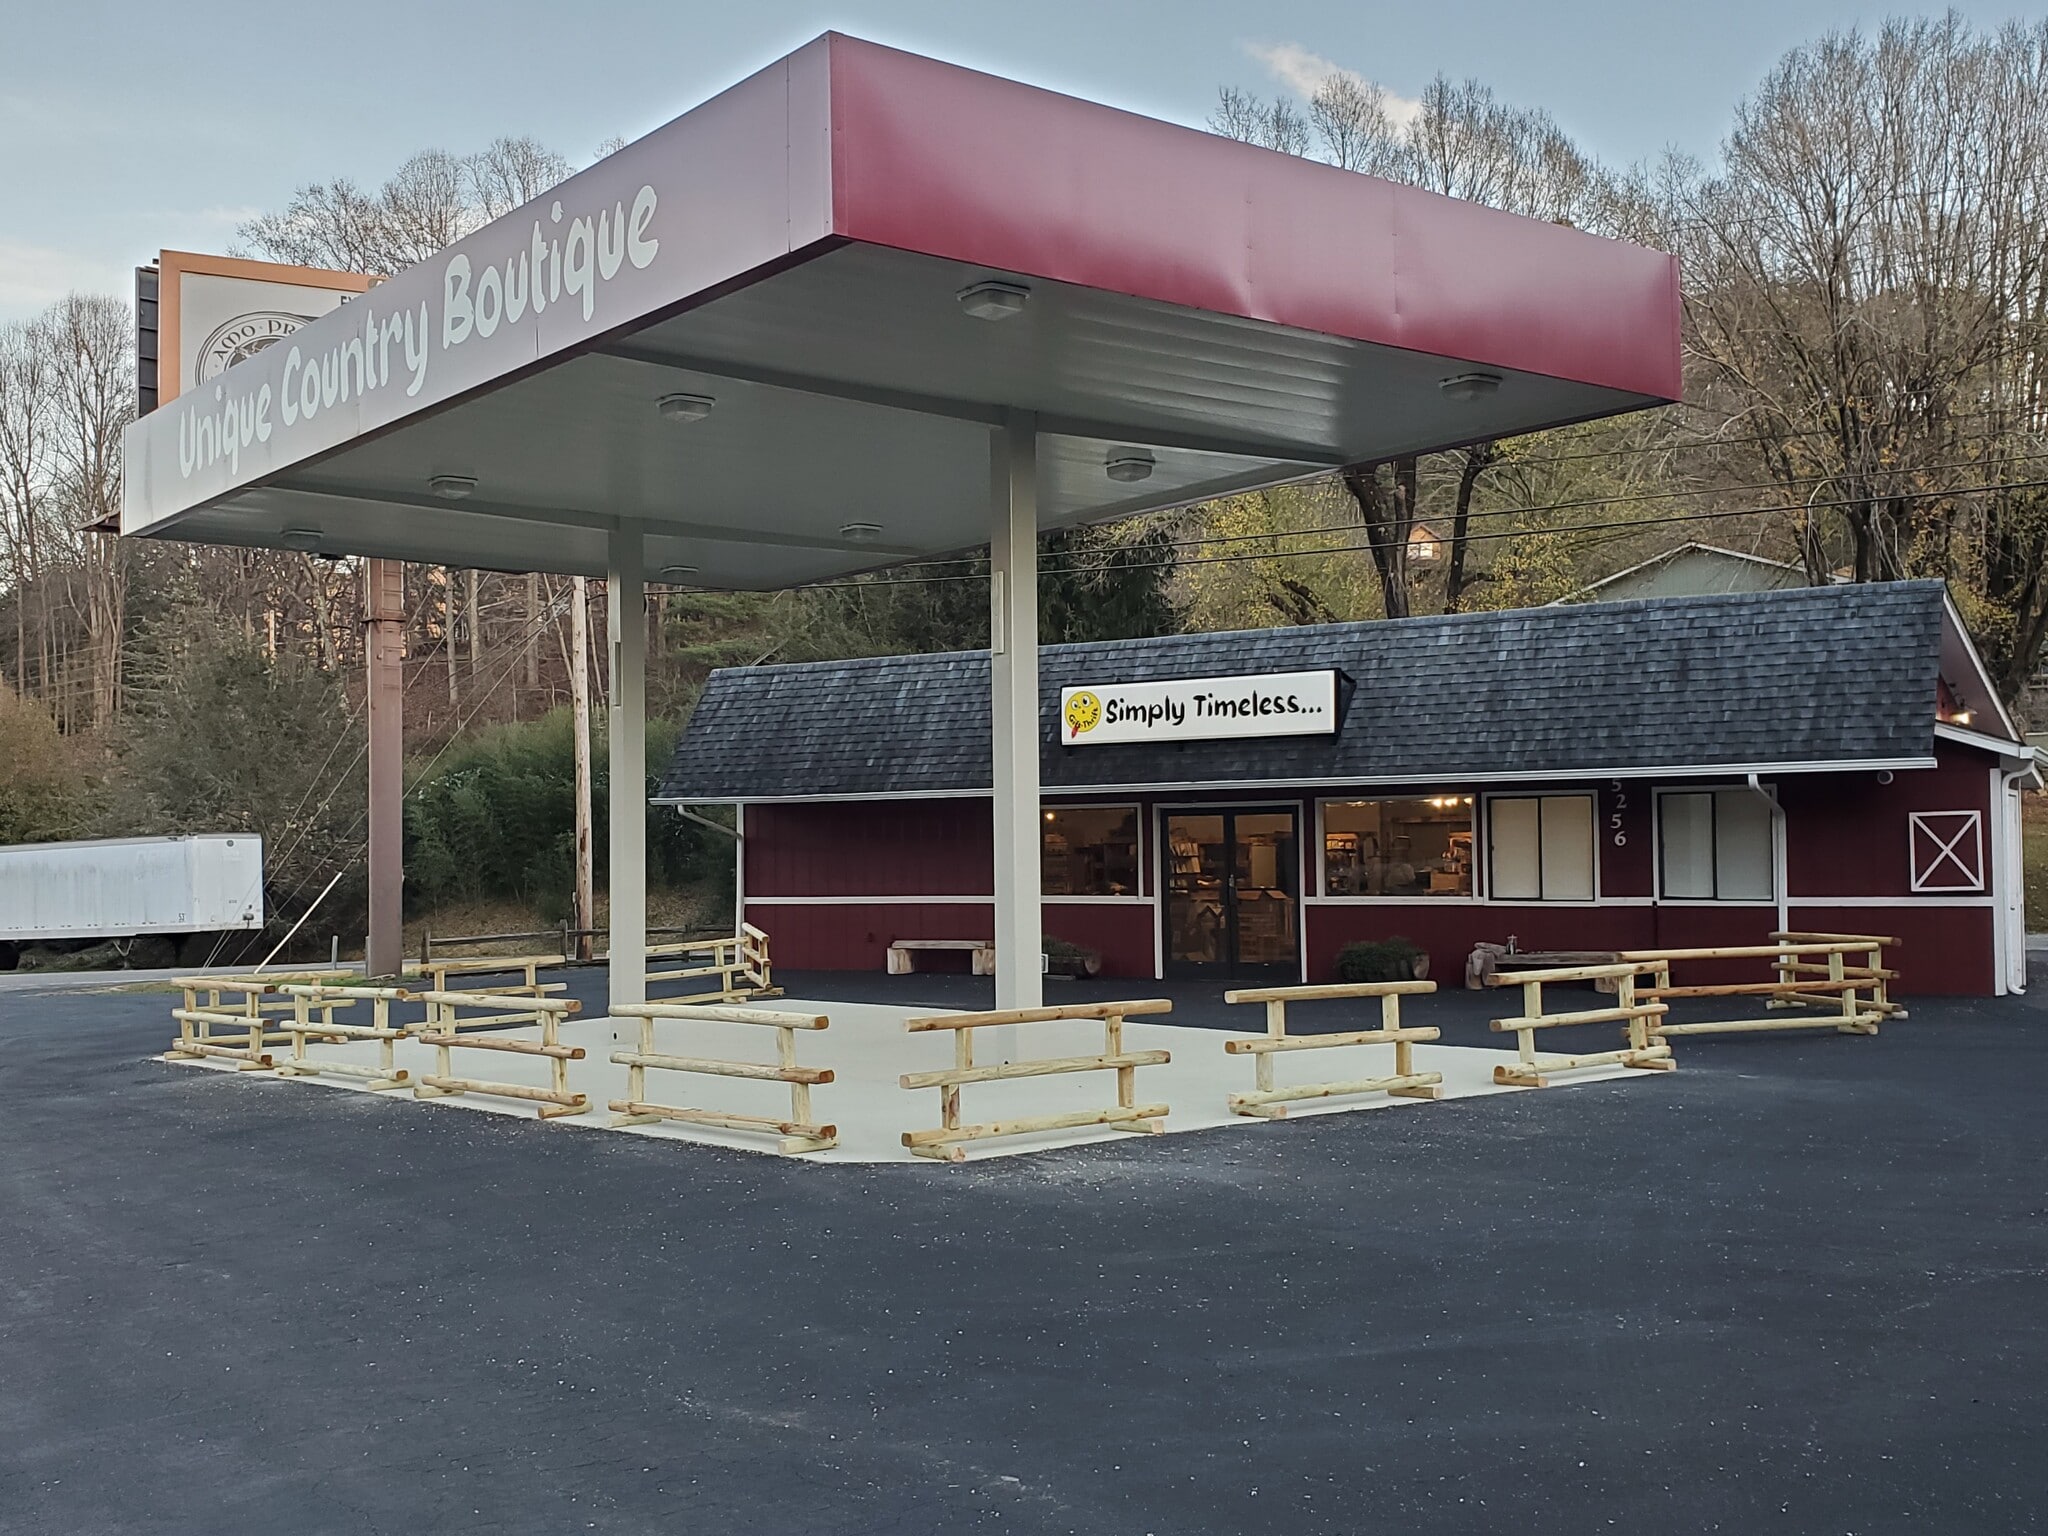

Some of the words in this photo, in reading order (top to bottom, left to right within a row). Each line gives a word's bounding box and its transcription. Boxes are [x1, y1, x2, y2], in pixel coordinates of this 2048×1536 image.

[179, 384, 272, 479] Unique
[281, 300, 428, 426] Country
[443, 185, 659, 349] Boutique
[1106, 694, 1185, 728] Simply
